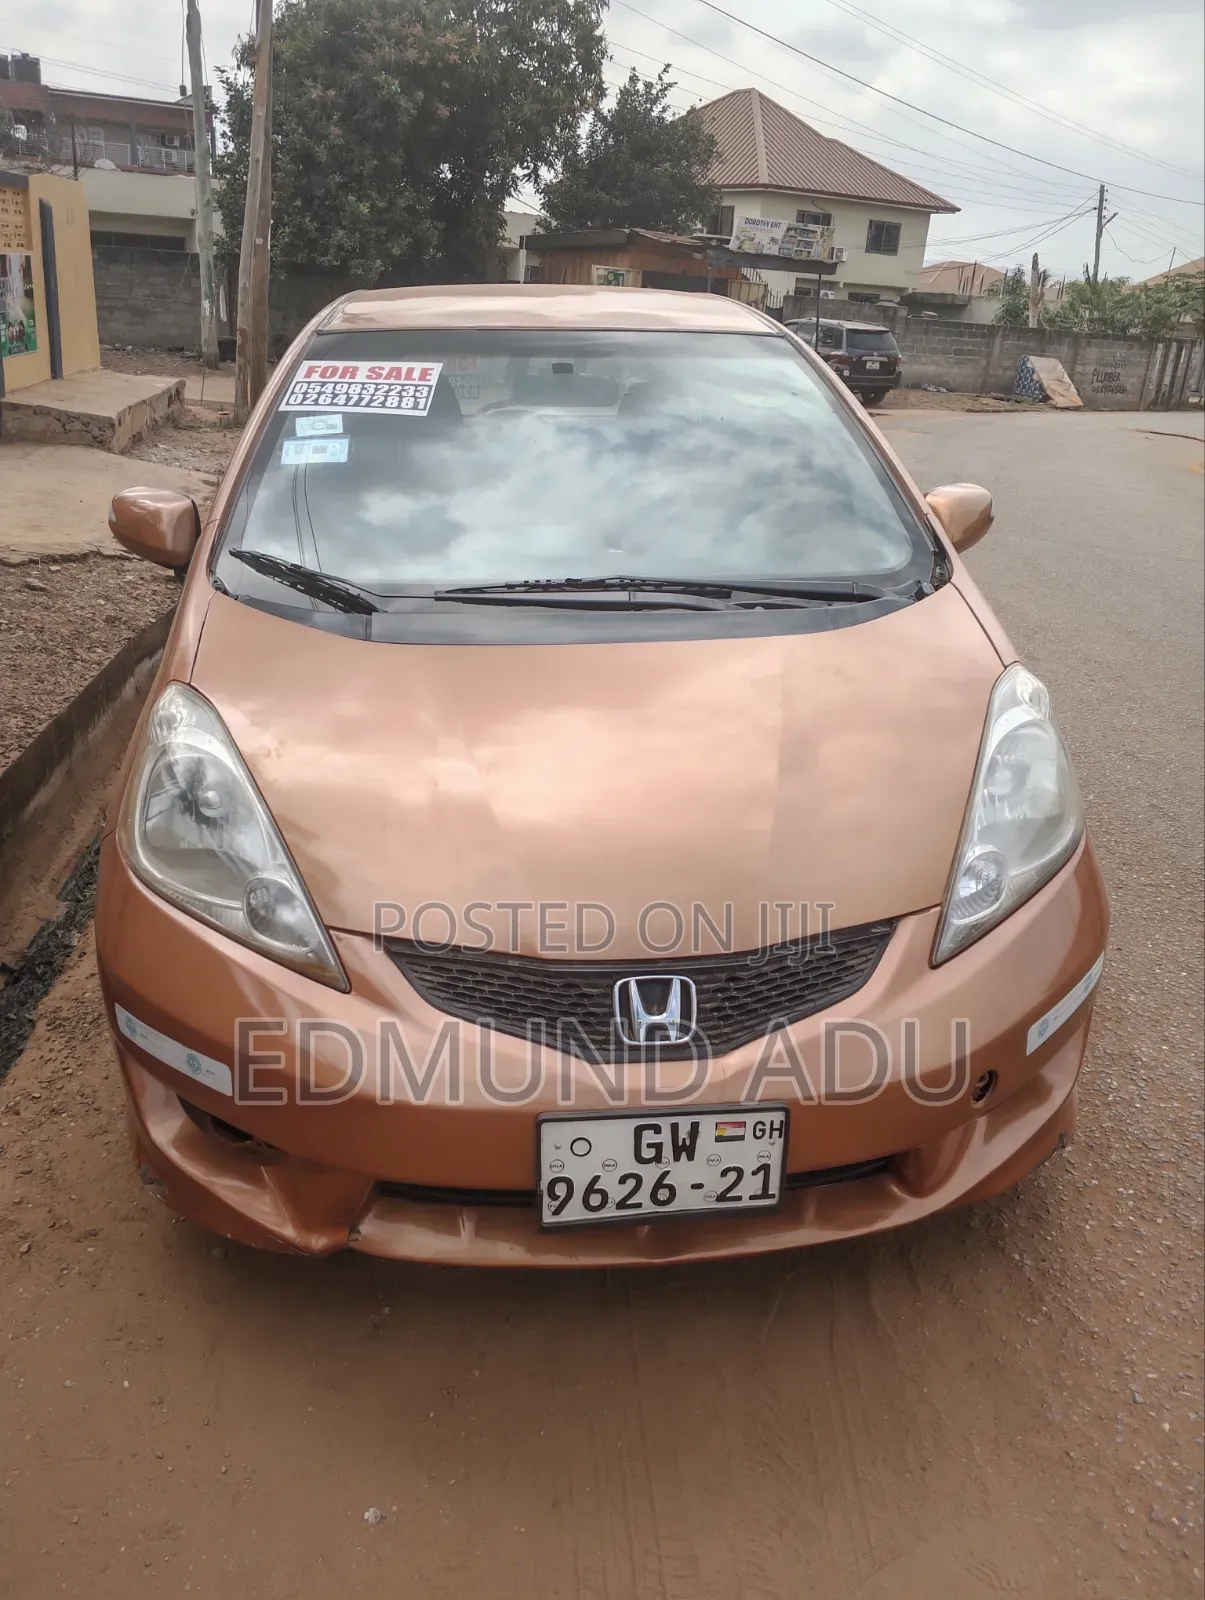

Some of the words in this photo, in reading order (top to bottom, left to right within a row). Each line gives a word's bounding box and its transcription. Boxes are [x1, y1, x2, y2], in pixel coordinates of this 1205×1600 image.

[744, 217, 770, 228] DOROTHY
[303, 365, 360, 380] FOR
[365, 366, 435, 382] SALE
[293, 382, 430, 398] 0549832233
[288, 393, 428, 409] 0264772881
[752, 1119, 784, 1140] GH
[633, 1121, 700, 1165] GW
[547, 1163, 776, 1216] 9626-21
